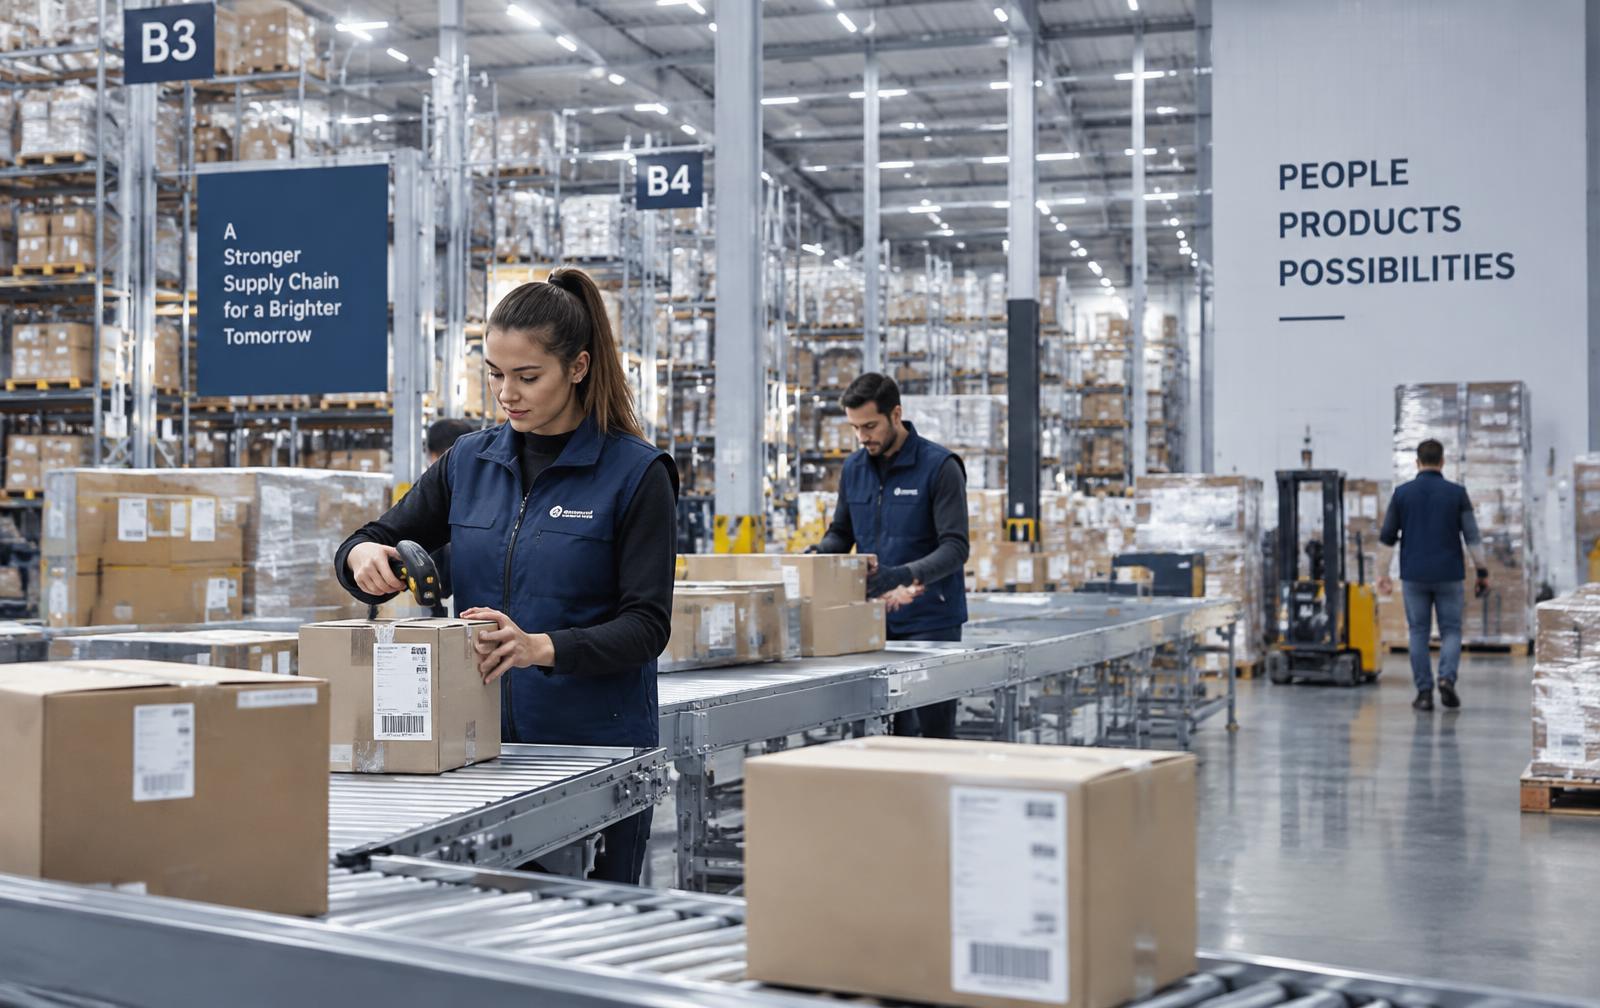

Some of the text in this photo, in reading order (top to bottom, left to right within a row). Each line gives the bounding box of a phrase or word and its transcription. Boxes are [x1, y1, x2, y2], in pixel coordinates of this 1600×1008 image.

[142, 18, 197, 64] B3
[647, 164, 691, 197] B4
[1279, 158, 1409, 191] PEOPLE
[223, 222, 237, 240] A
[1279, 205, 1462, 239] PRODUCTS
[223, 248, 302, 269] Stronger
[1279, 251, 1516, 287] POSSIBILITIES
[223, 271, 339, 296] Supply Chain
[223, 299, 342, 321] for a Brighter
[223, 328, 312, 345] Tomorrow
